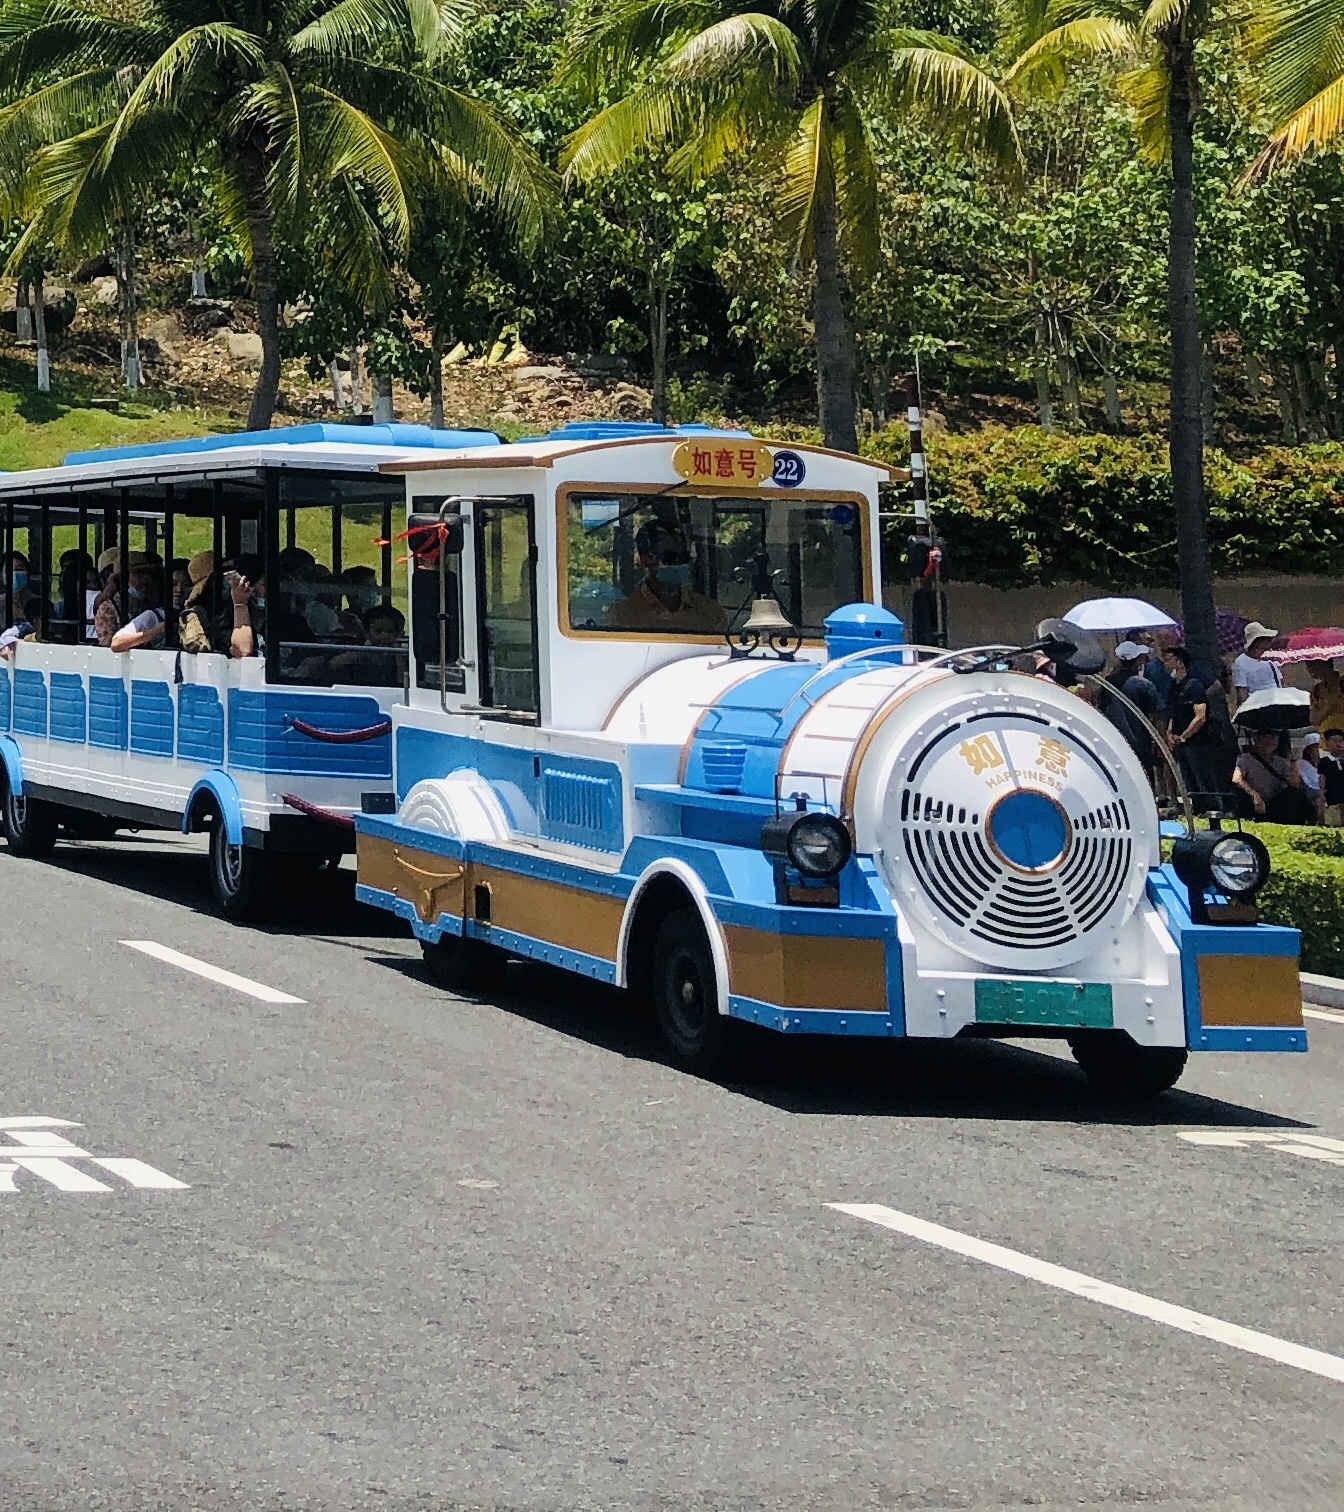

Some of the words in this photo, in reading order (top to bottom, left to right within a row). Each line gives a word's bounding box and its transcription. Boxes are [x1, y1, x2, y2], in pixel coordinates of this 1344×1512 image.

[692, 447, 757, 478] 如意号
[775, 458, 799, 481] 22
[959, 734, 1071, 778] 如意
[985, 770, 1064, 792] HAPPINESS
